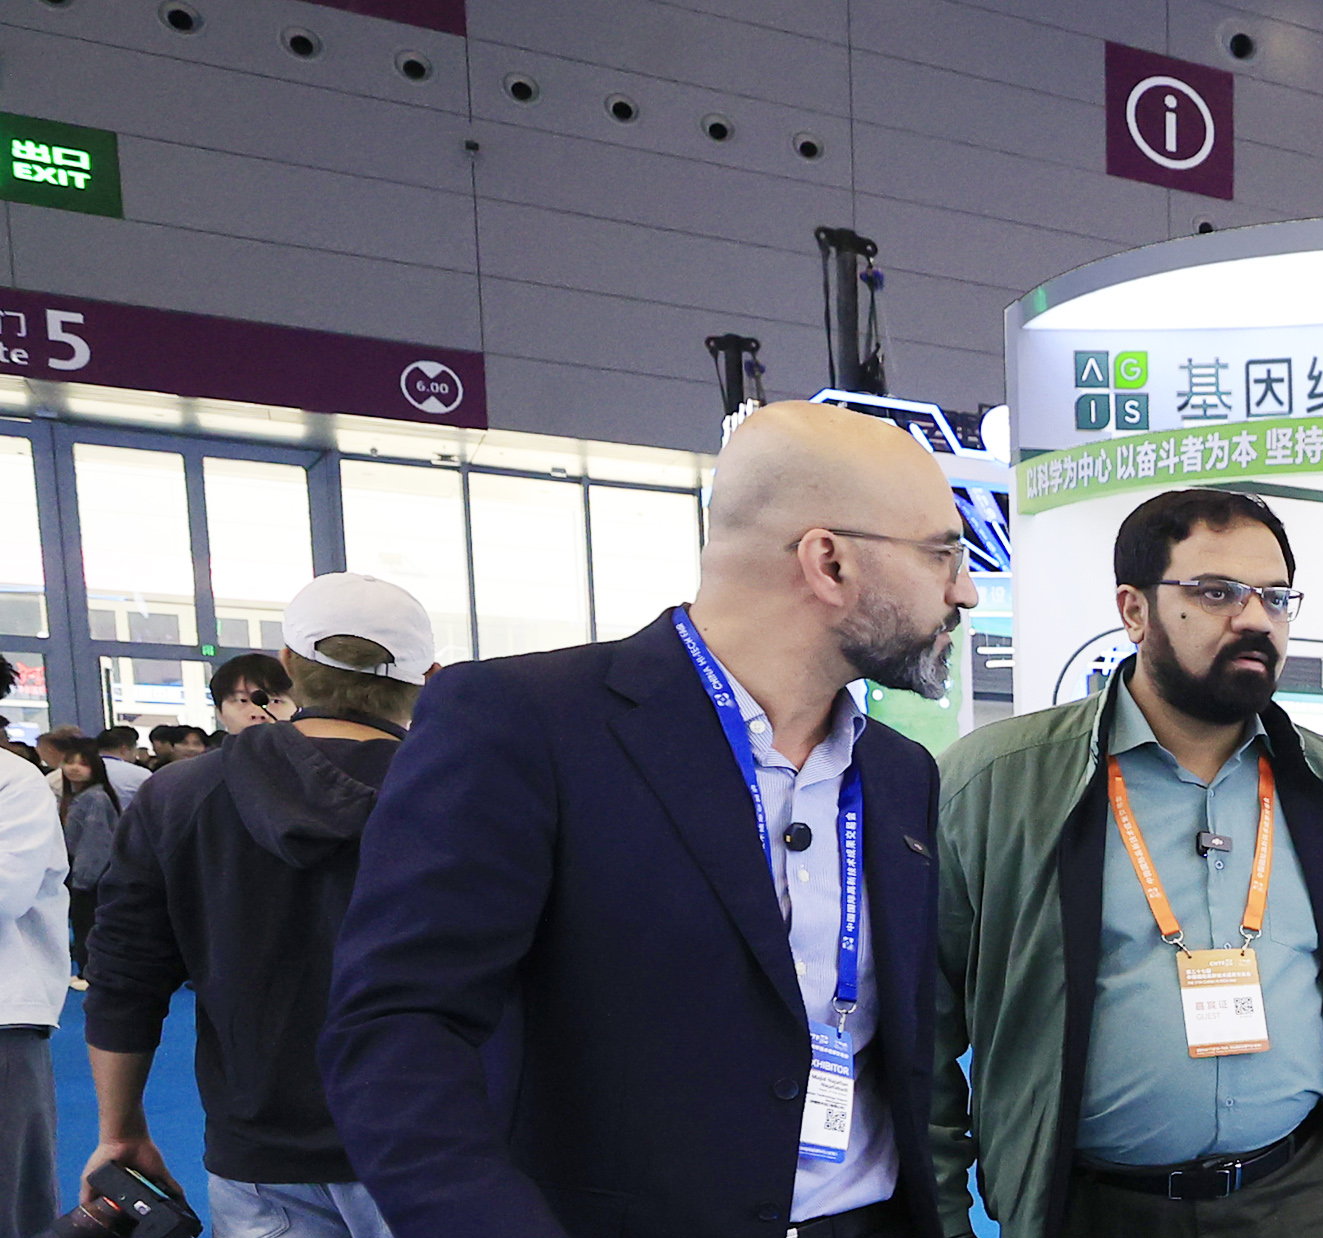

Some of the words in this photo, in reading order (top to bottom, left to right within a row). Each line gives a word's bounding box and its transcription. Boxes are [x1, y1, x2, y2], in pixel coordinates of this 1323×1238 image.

[12, 139, 91, 170] 出口
[13, 161, 91, 189] EXIT
[46, 308, 91, 371] 5
[416, 380, 449, 394] 6.00
[1026, 450, 1113, 499] 以科学为中心
[1116, 429, 1258, 480] 以奋斗者为本
[703, 665, 723, 690] CHINA
[811, 1058, 850, 1076] XHIBITOR
